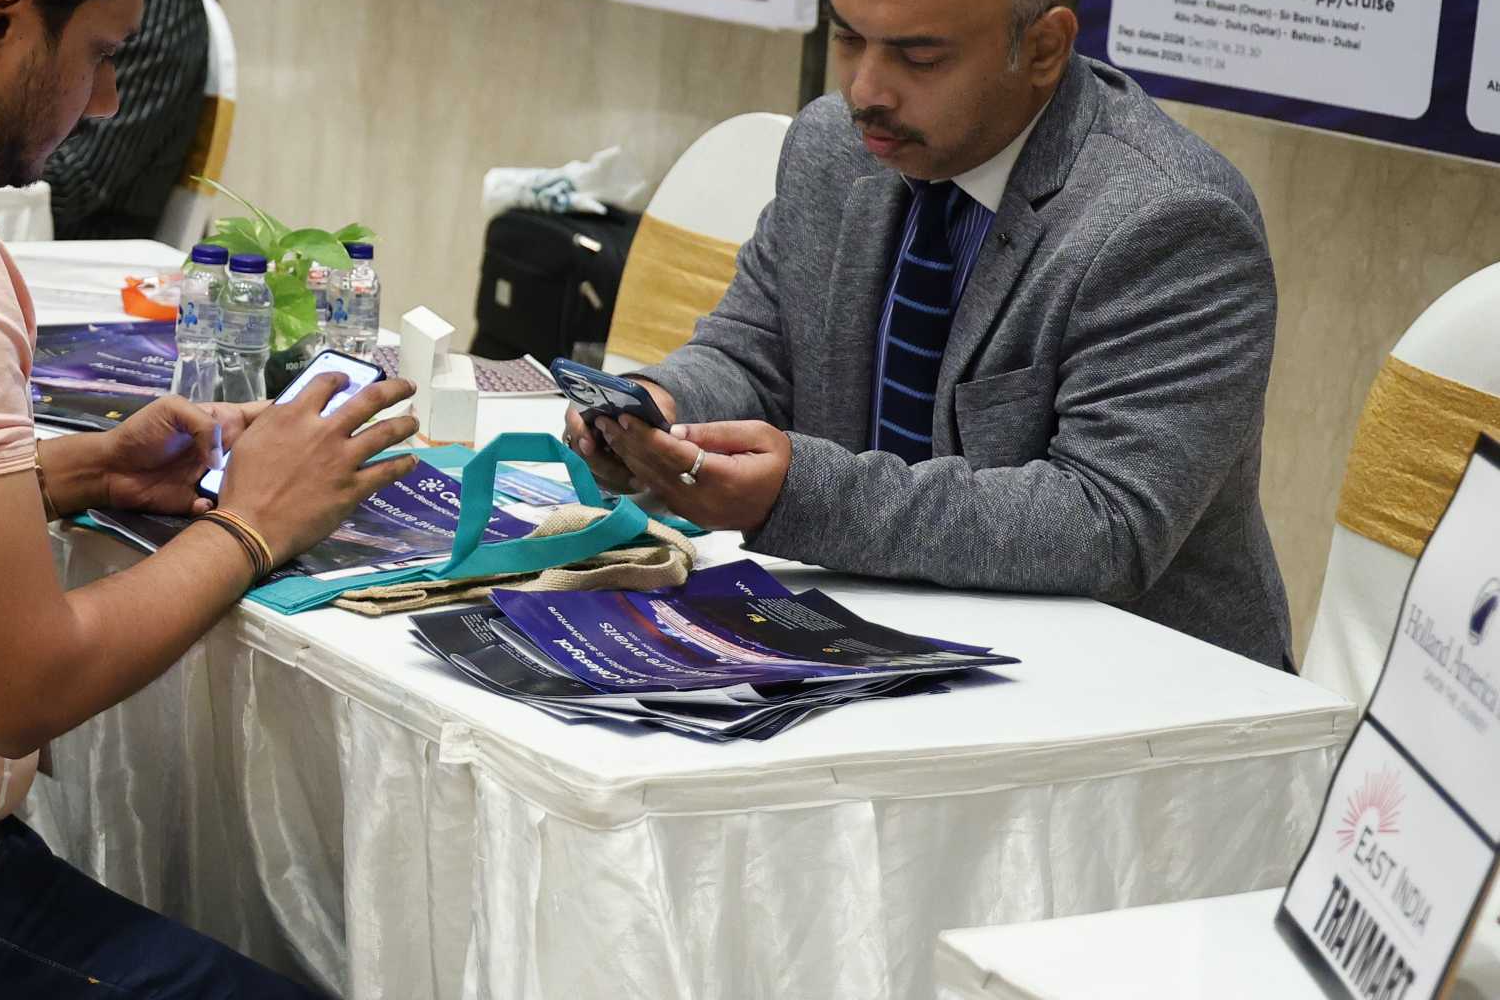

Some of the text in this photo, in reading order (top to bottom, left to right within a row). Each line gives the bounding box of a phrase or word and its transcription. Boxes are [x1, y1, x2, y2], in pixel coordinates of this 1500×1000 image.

[1333, 35, 1360, 50] Dubai
[368, 492, 418, 523] venture
[394, 480, 416, 499] every
[548, 605, 586, 642] adventure
[598, 621, 648, 658] awaits
[553, 637, 620, 682] Celestyal
[585, 641, 598, 652] an
[1354, 825, 1433, 937] EAST INDIA
[1313, 872, 1416, 1000] TRAVMART
